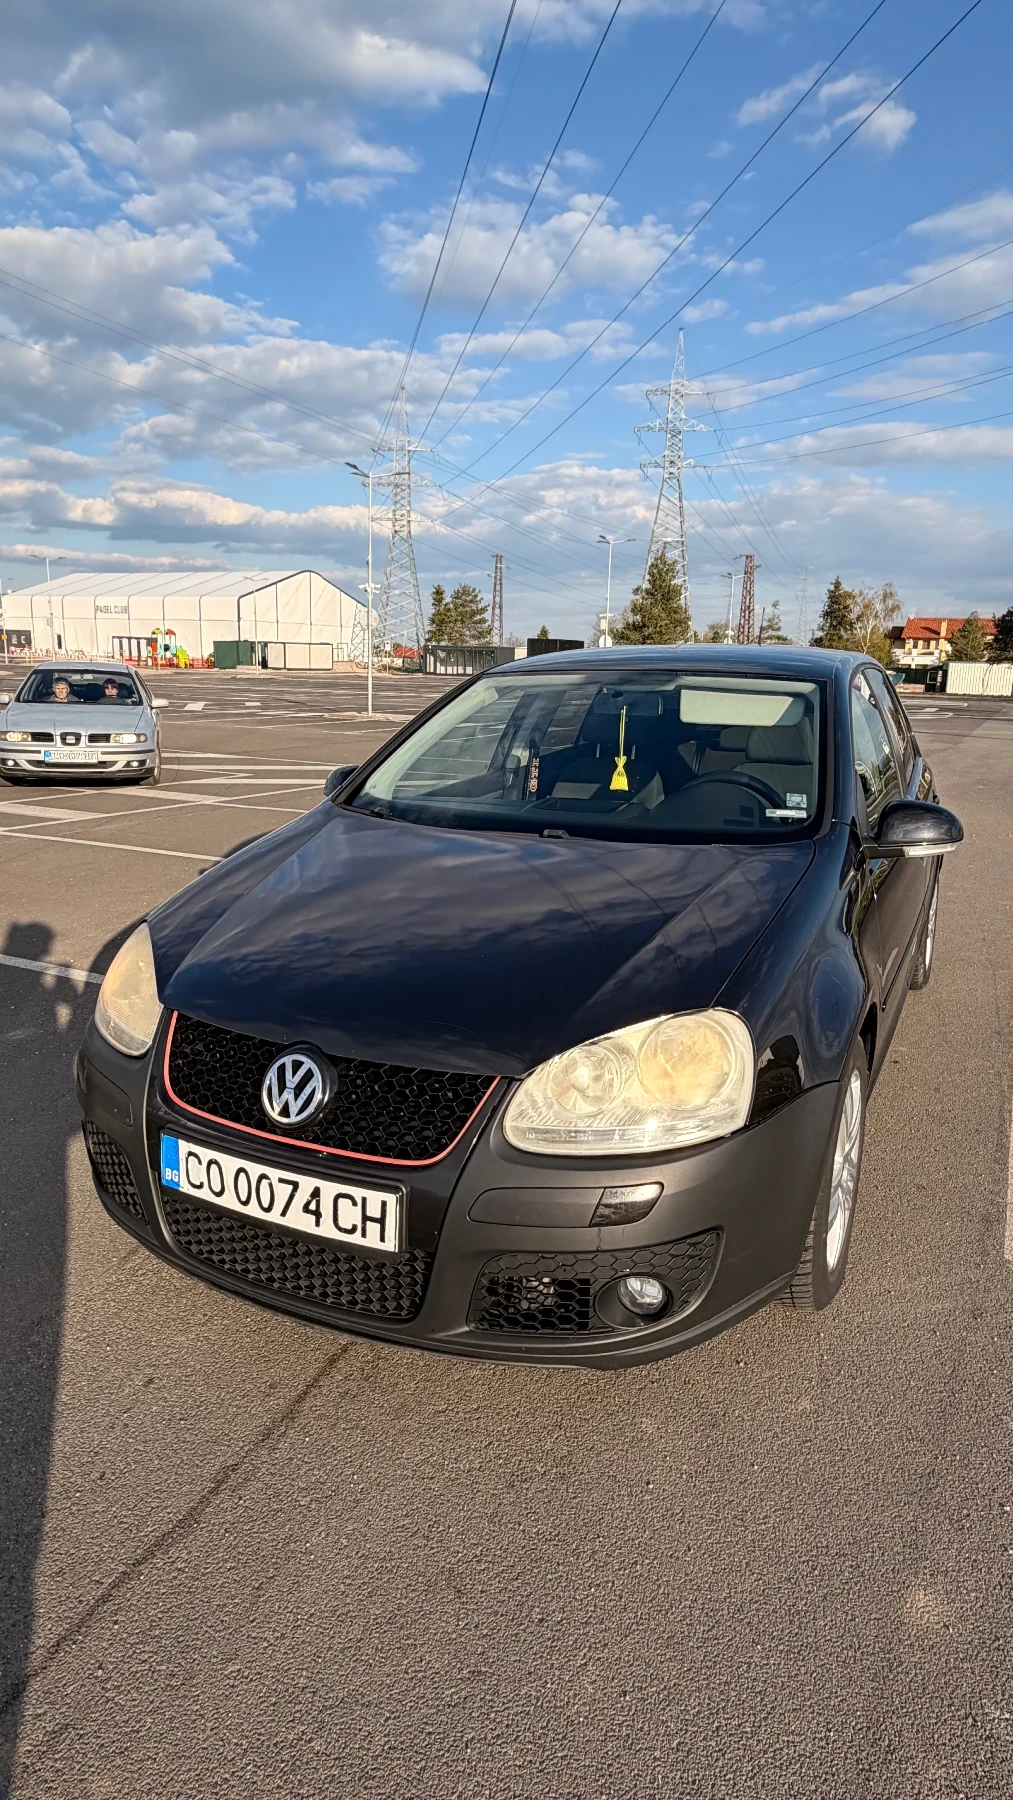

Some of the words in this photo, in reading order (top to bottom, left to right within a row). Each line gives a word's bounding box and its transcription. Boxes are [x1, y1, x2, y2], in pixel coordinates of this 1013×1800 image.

[95, 605, 113, 614] PADEL
[114, 605, 128, 614] CLUB
[263, 1053, 323, 1125] VW
[165, 1168, 180, 1182] BG
[233, 1166, 323, 1228] 0074
